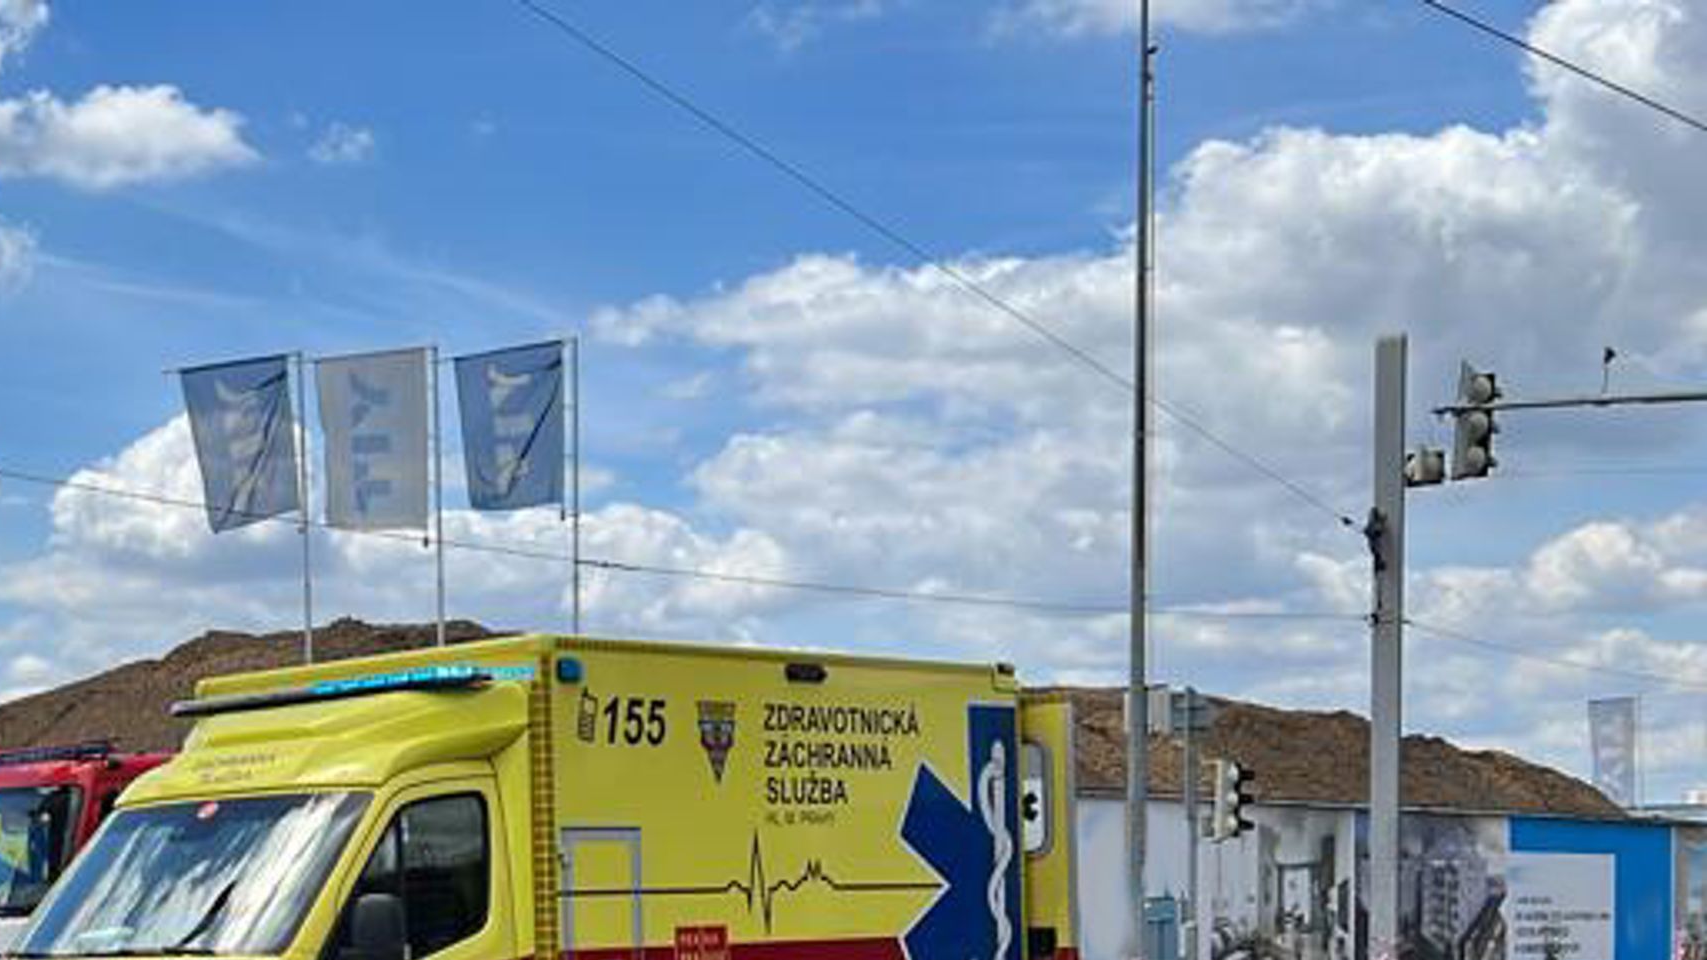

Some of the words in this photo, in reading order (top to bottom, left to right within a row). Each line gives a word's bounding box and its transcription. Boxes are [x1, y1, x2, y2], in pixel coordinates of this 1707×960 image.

[603, 696, 666, 746] 155
[763, 702, 920, 735] ZDRAVOTNICKÁ
[763, 734, 892, 770] ZÁCHRANNÁ
[766, 770, 848, 804] SLUŽBA
